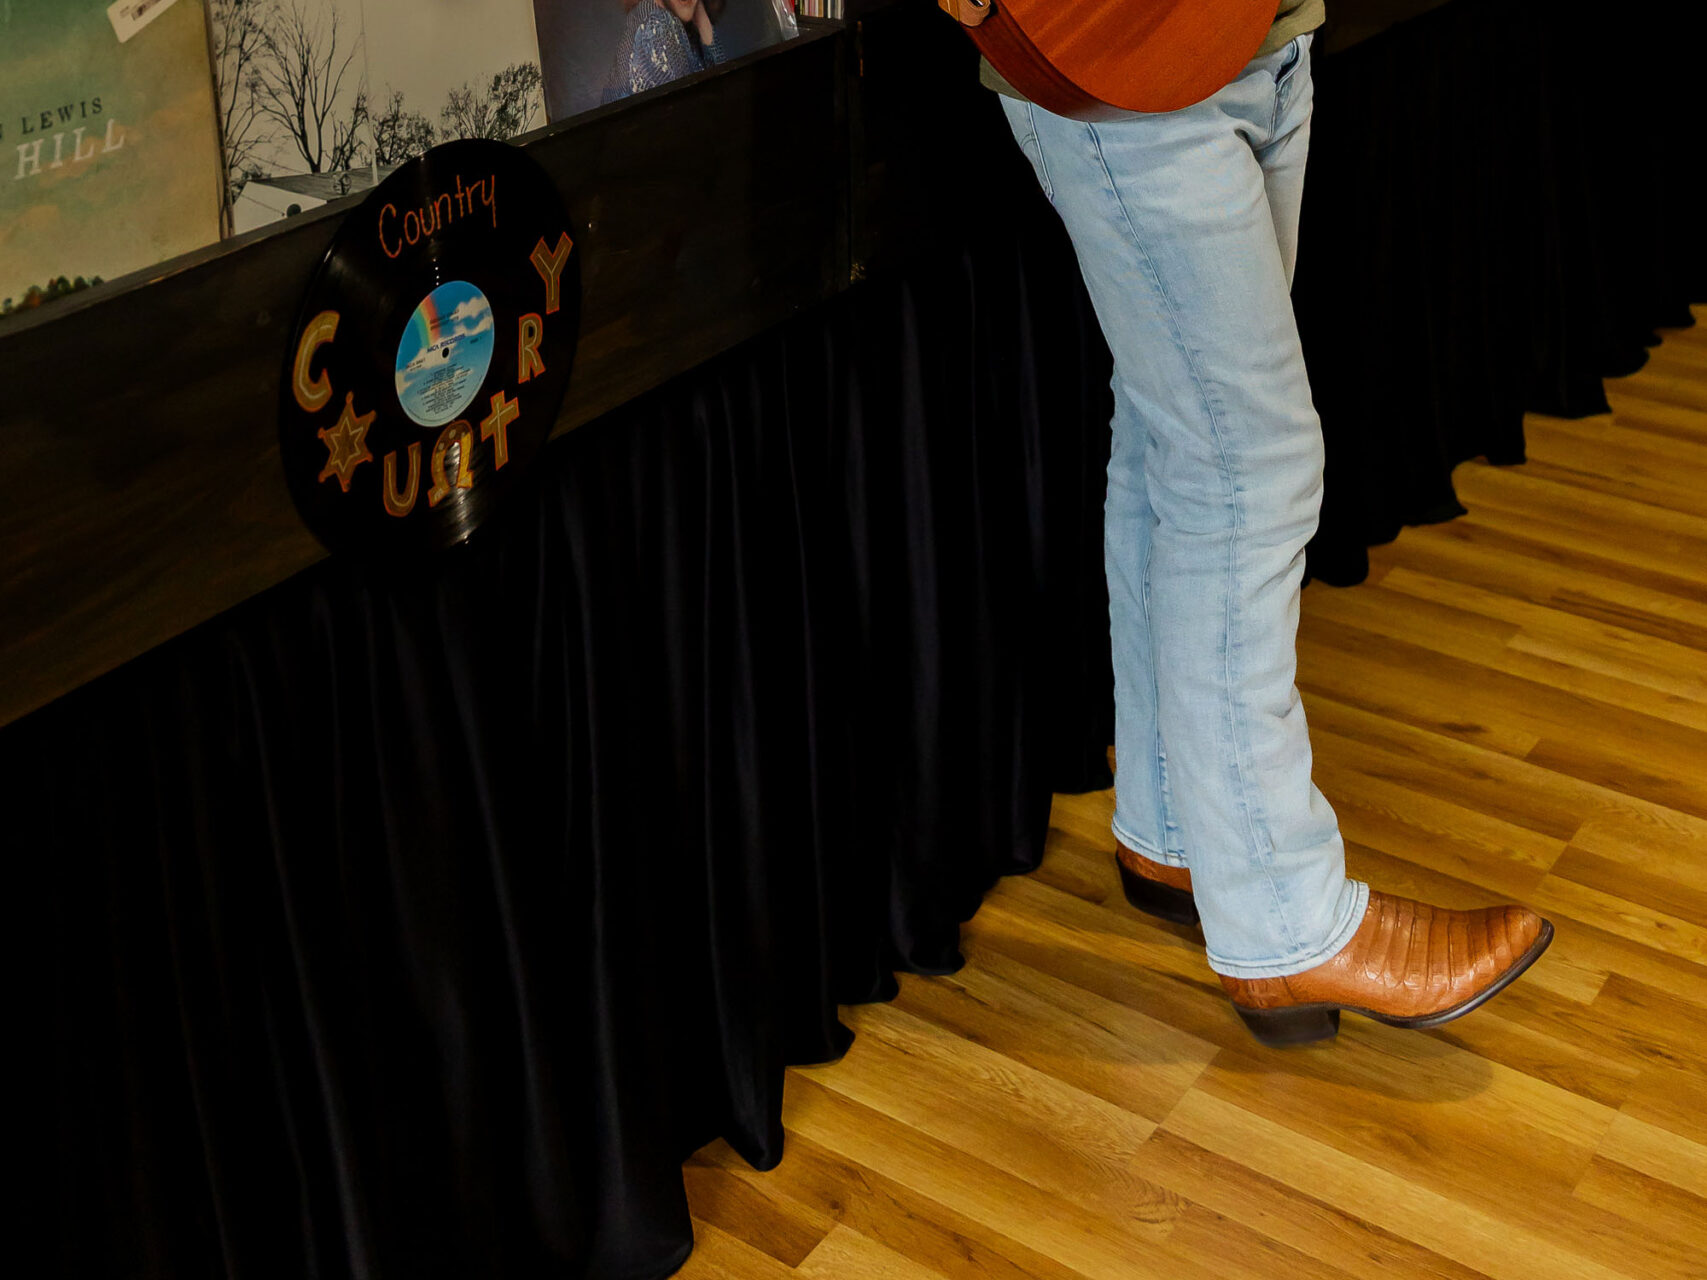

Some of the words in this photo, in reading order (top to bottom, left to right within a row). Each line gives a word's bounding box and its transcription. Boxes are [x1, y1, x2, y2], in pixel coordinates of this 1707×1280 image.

[22, 97, 103, 135] LEWIS
[14, 118, 126, 181] HILL
[379, 174, 497, 258] Country
